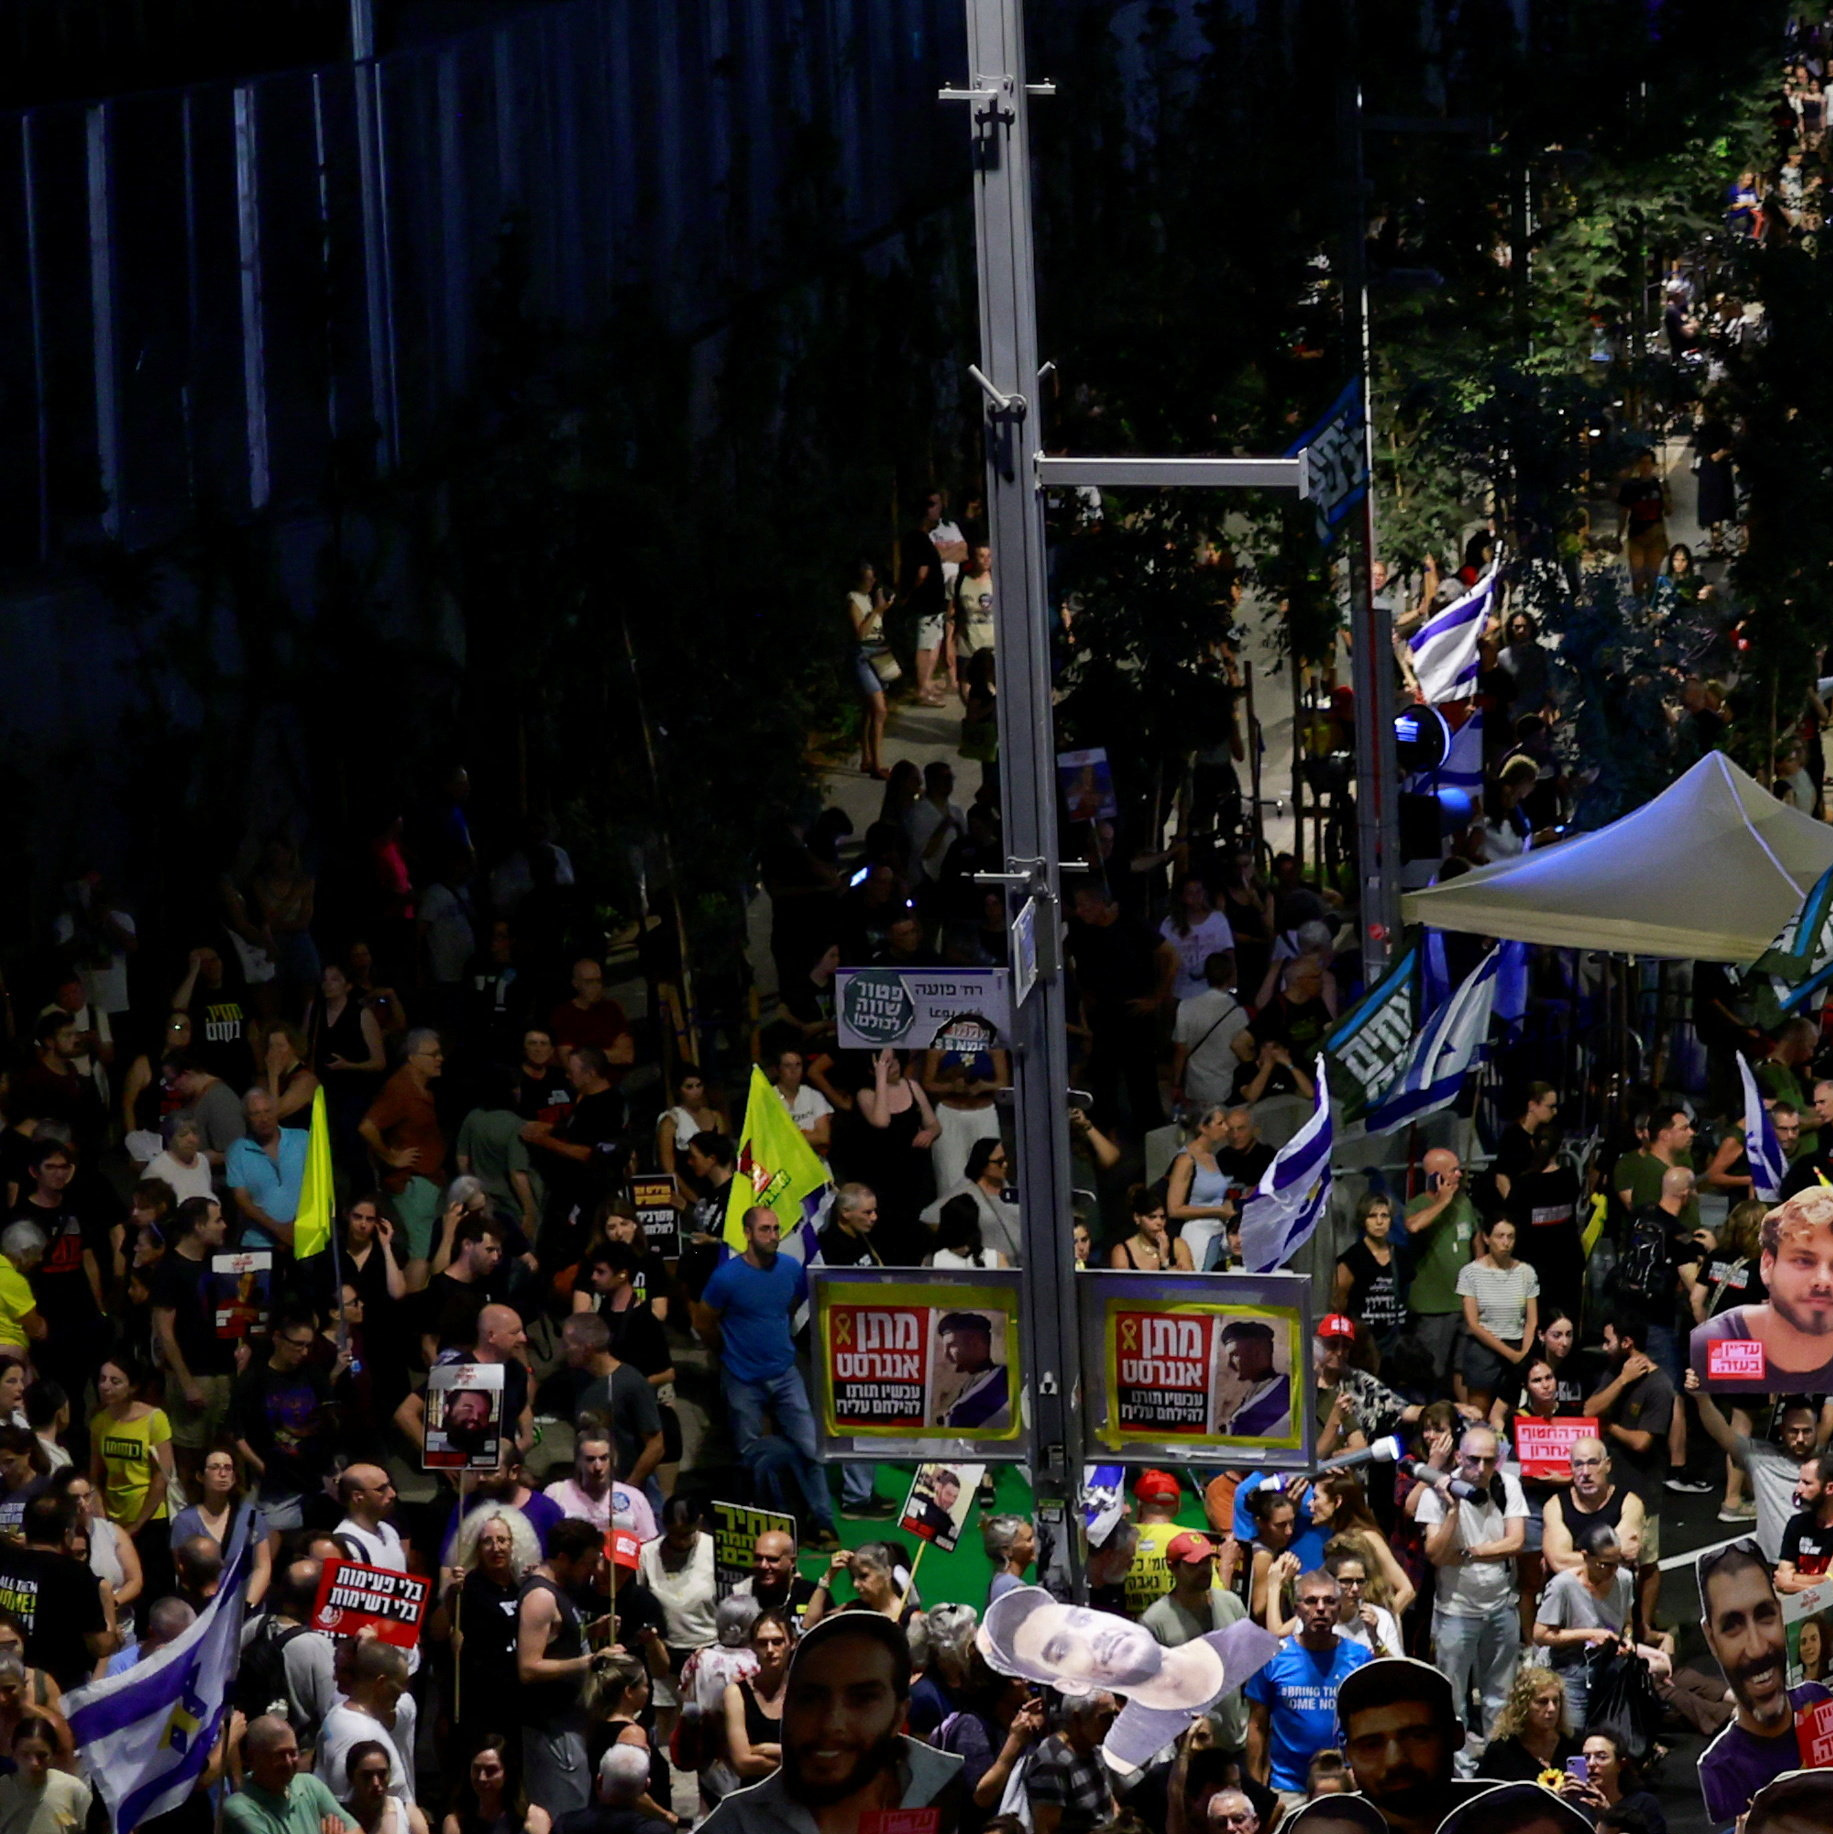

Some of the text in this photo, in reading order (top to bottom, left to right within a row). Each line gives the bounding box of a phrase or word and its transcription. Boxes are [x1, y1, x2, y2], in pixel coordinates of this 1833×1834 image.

[858, 982, 903, 1000] פטור
[914, 983, 957, 997] פועה
[856, 1000, 901, 1014] שווה
[855, 1311, 920, 1352] מתן
[1142, 1317, 1202, 1359] מתן
[1725, 1344, 1760, 1357] עדיין
[836, 1352, 921, 1380] אנגרסט
[1122, 1358, 1203, 1388] אנגרסט
[1716, 1359, 1760, 1372] בעזה.
[882, 1384, 921, 1400] עכשיו
[1164, 1390, 1204, 1407] עכשיו
[873, 1399, 921, 1416] להילחם
[1521, 1426, 1577, 1442] החטוף
[336, 1565, 424, 1602] בלי פעימות
[329, 1585, 419, 1623] בלי רשימות
